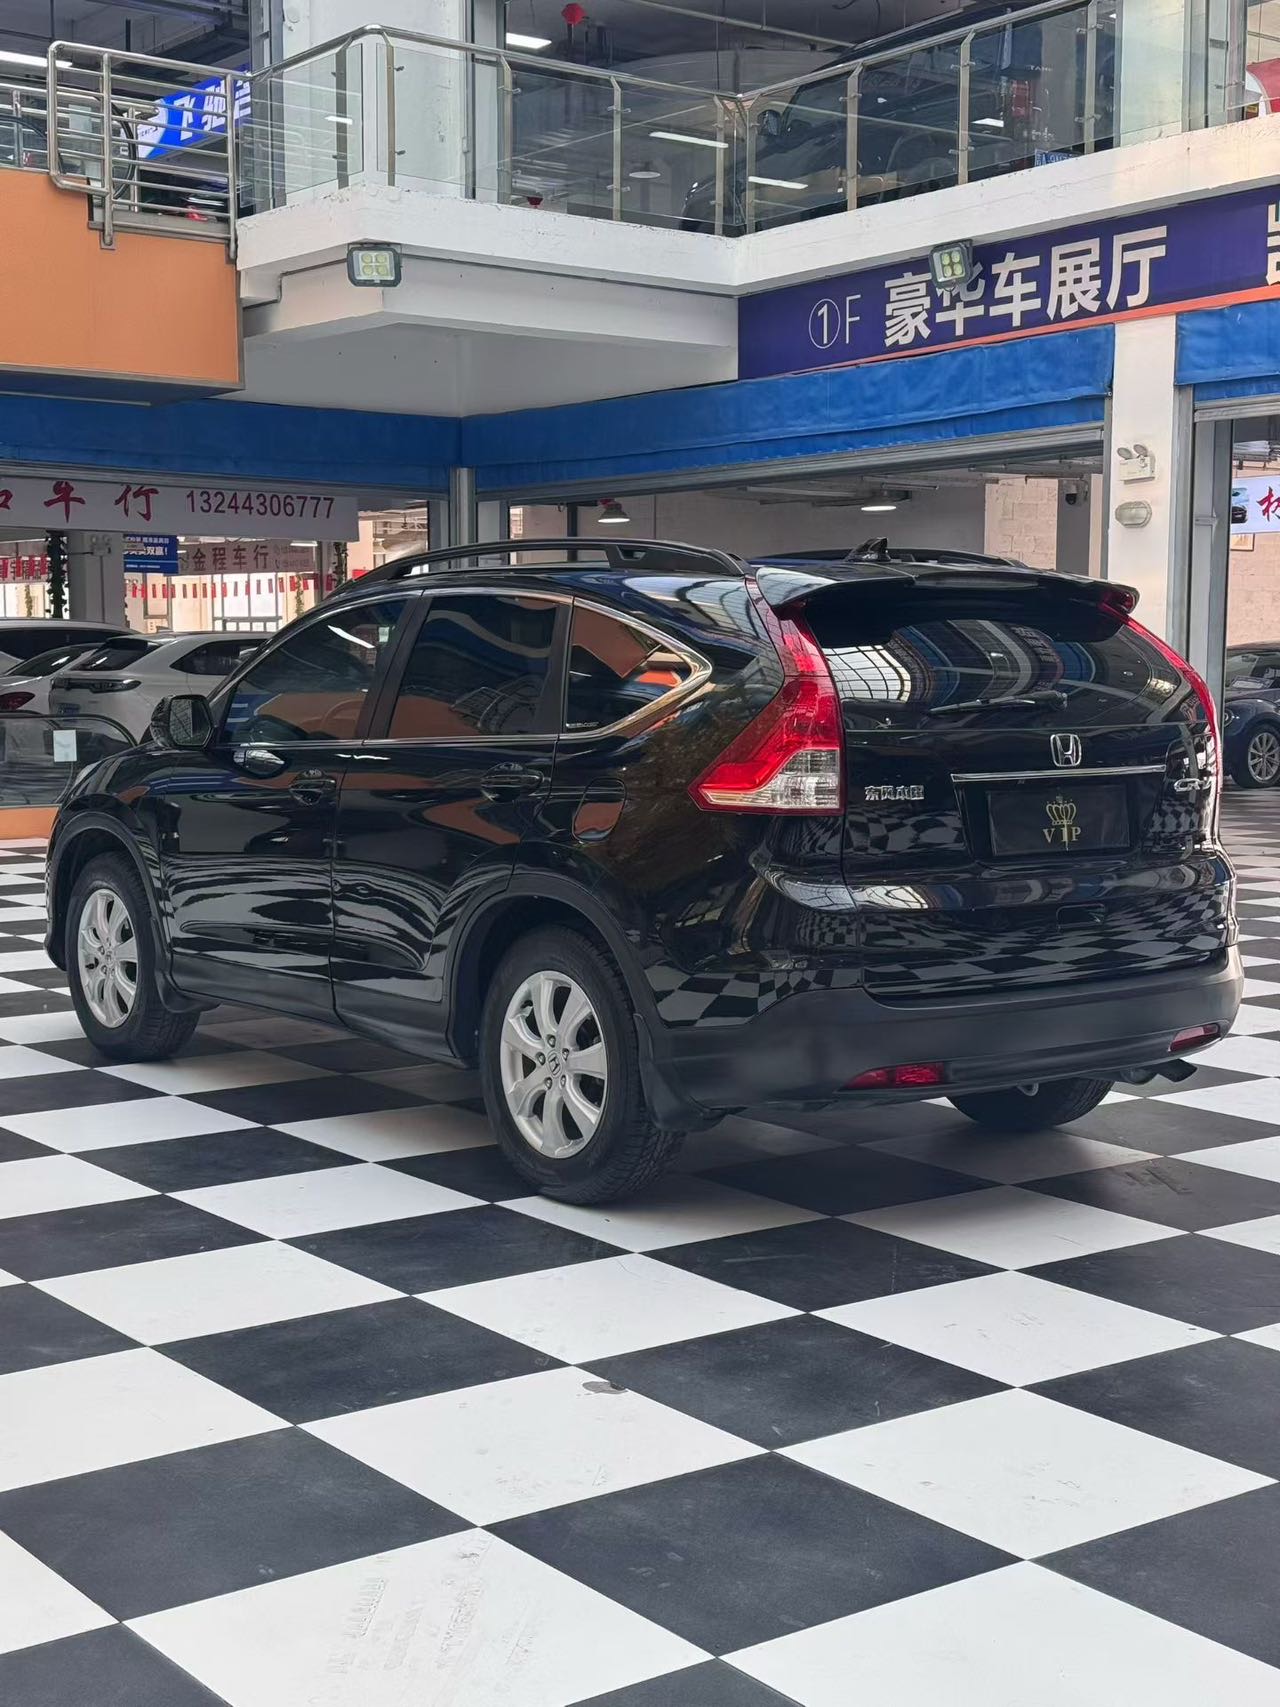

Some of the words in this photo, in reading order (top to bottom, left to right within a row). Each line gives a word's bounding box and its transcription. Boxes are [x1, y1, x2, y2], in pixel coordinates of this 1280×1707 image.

[884, 226, 1167, 347] 豪华车展厅
[187, 490, 335, 518] 13244306777
[192, 545, 268, 571] 金程车行
[1042, 827, 1081, 843] VIP
